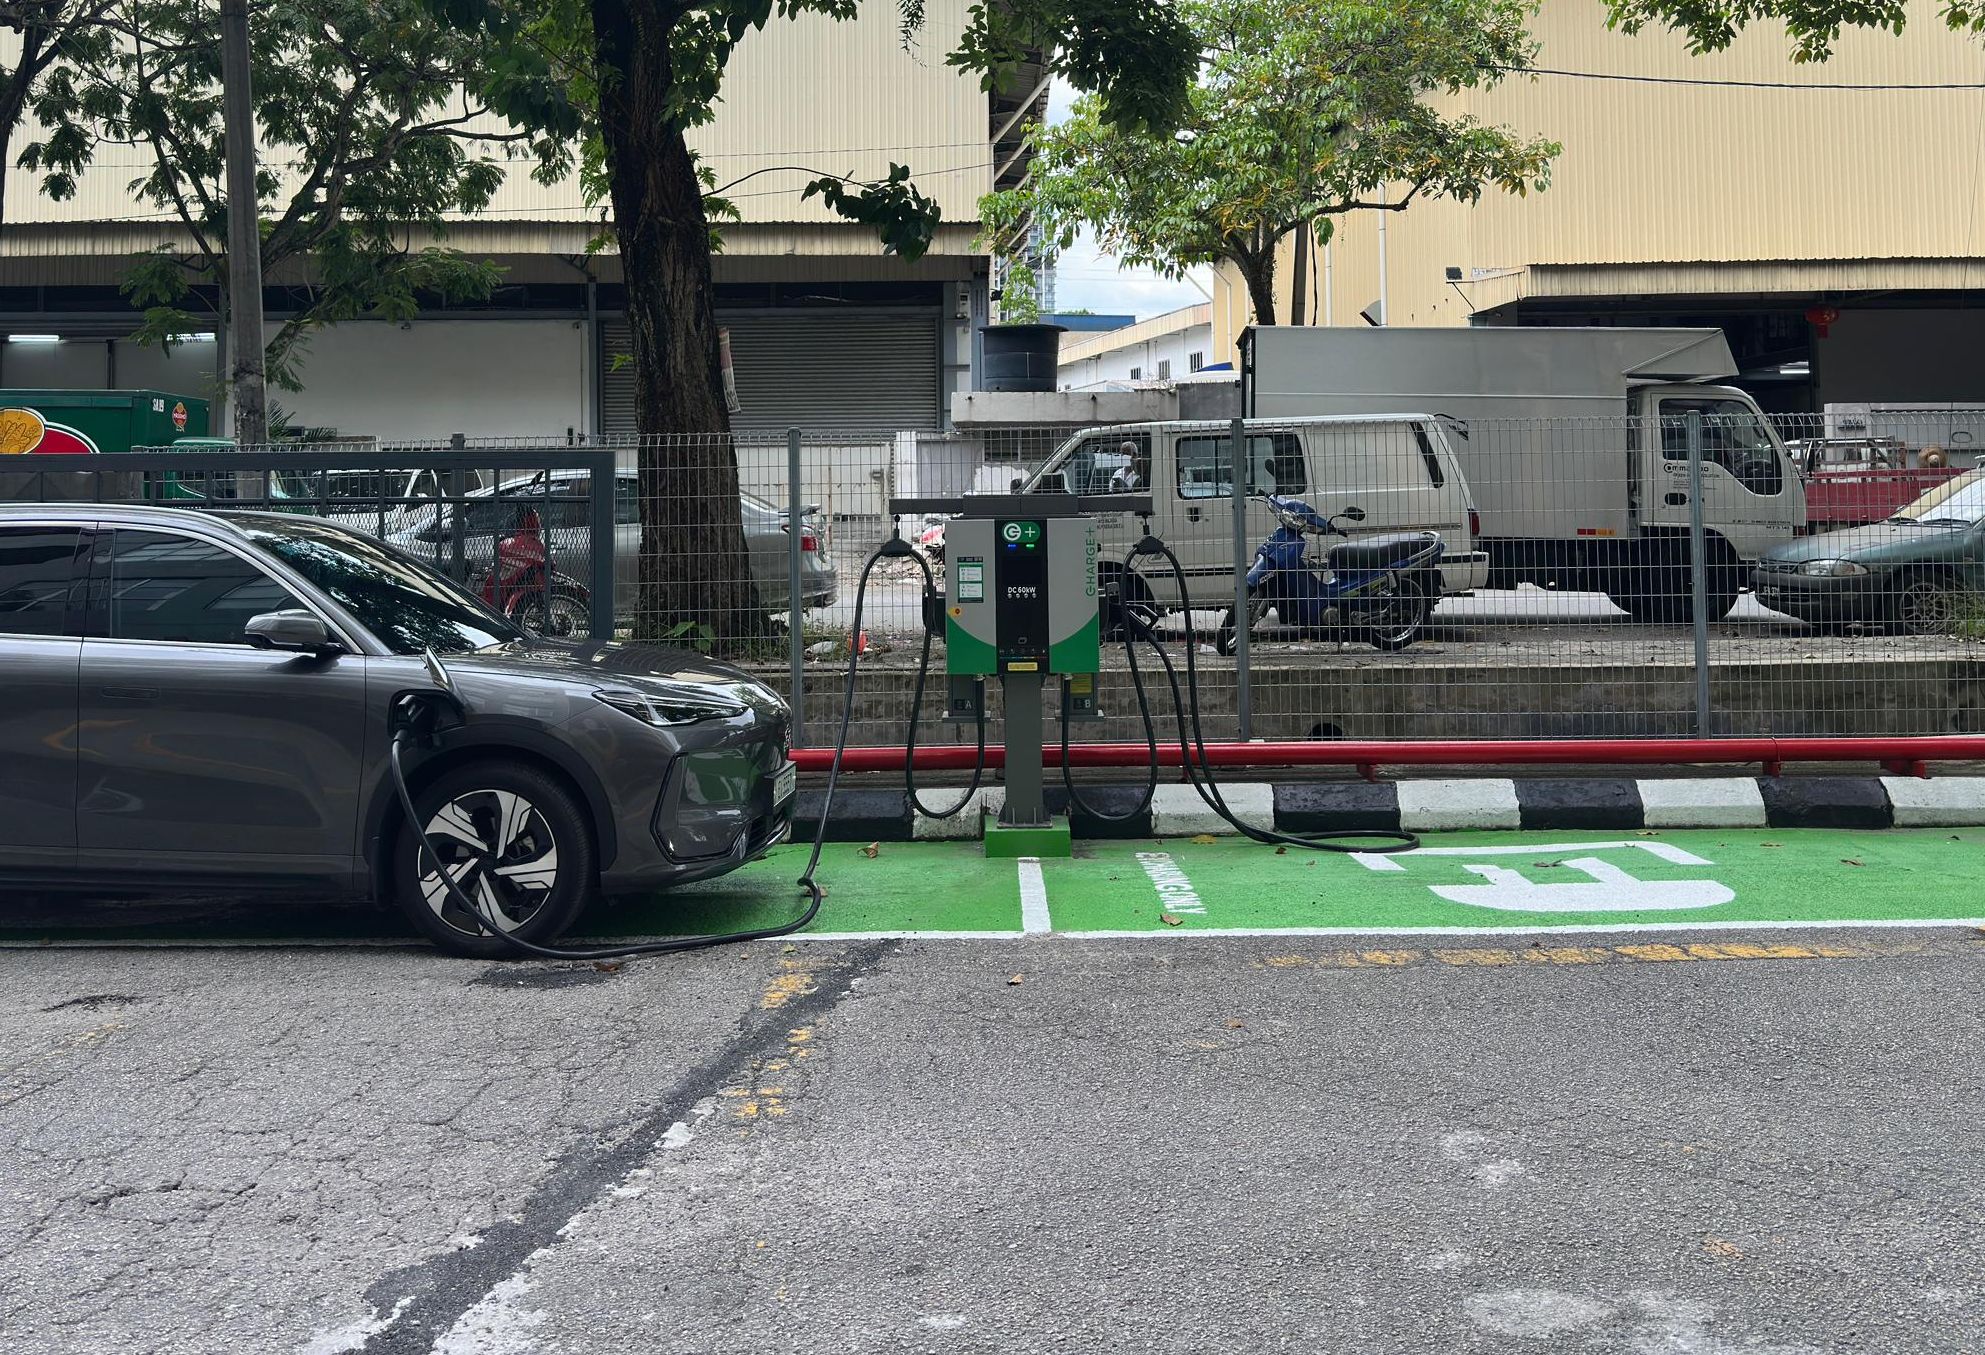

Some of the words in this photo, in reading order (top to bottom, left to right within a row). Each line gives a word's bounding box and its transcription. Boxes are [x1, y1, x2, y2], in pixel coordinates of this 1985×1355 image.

[1007, 586, 1017, 594] DC
[1017, 586, 1036, 594] 60kW
[965, 700, 972, 709] A
[1084, 699, 1091, 709] B
[1158, 891, 1208, 914] ONLY
